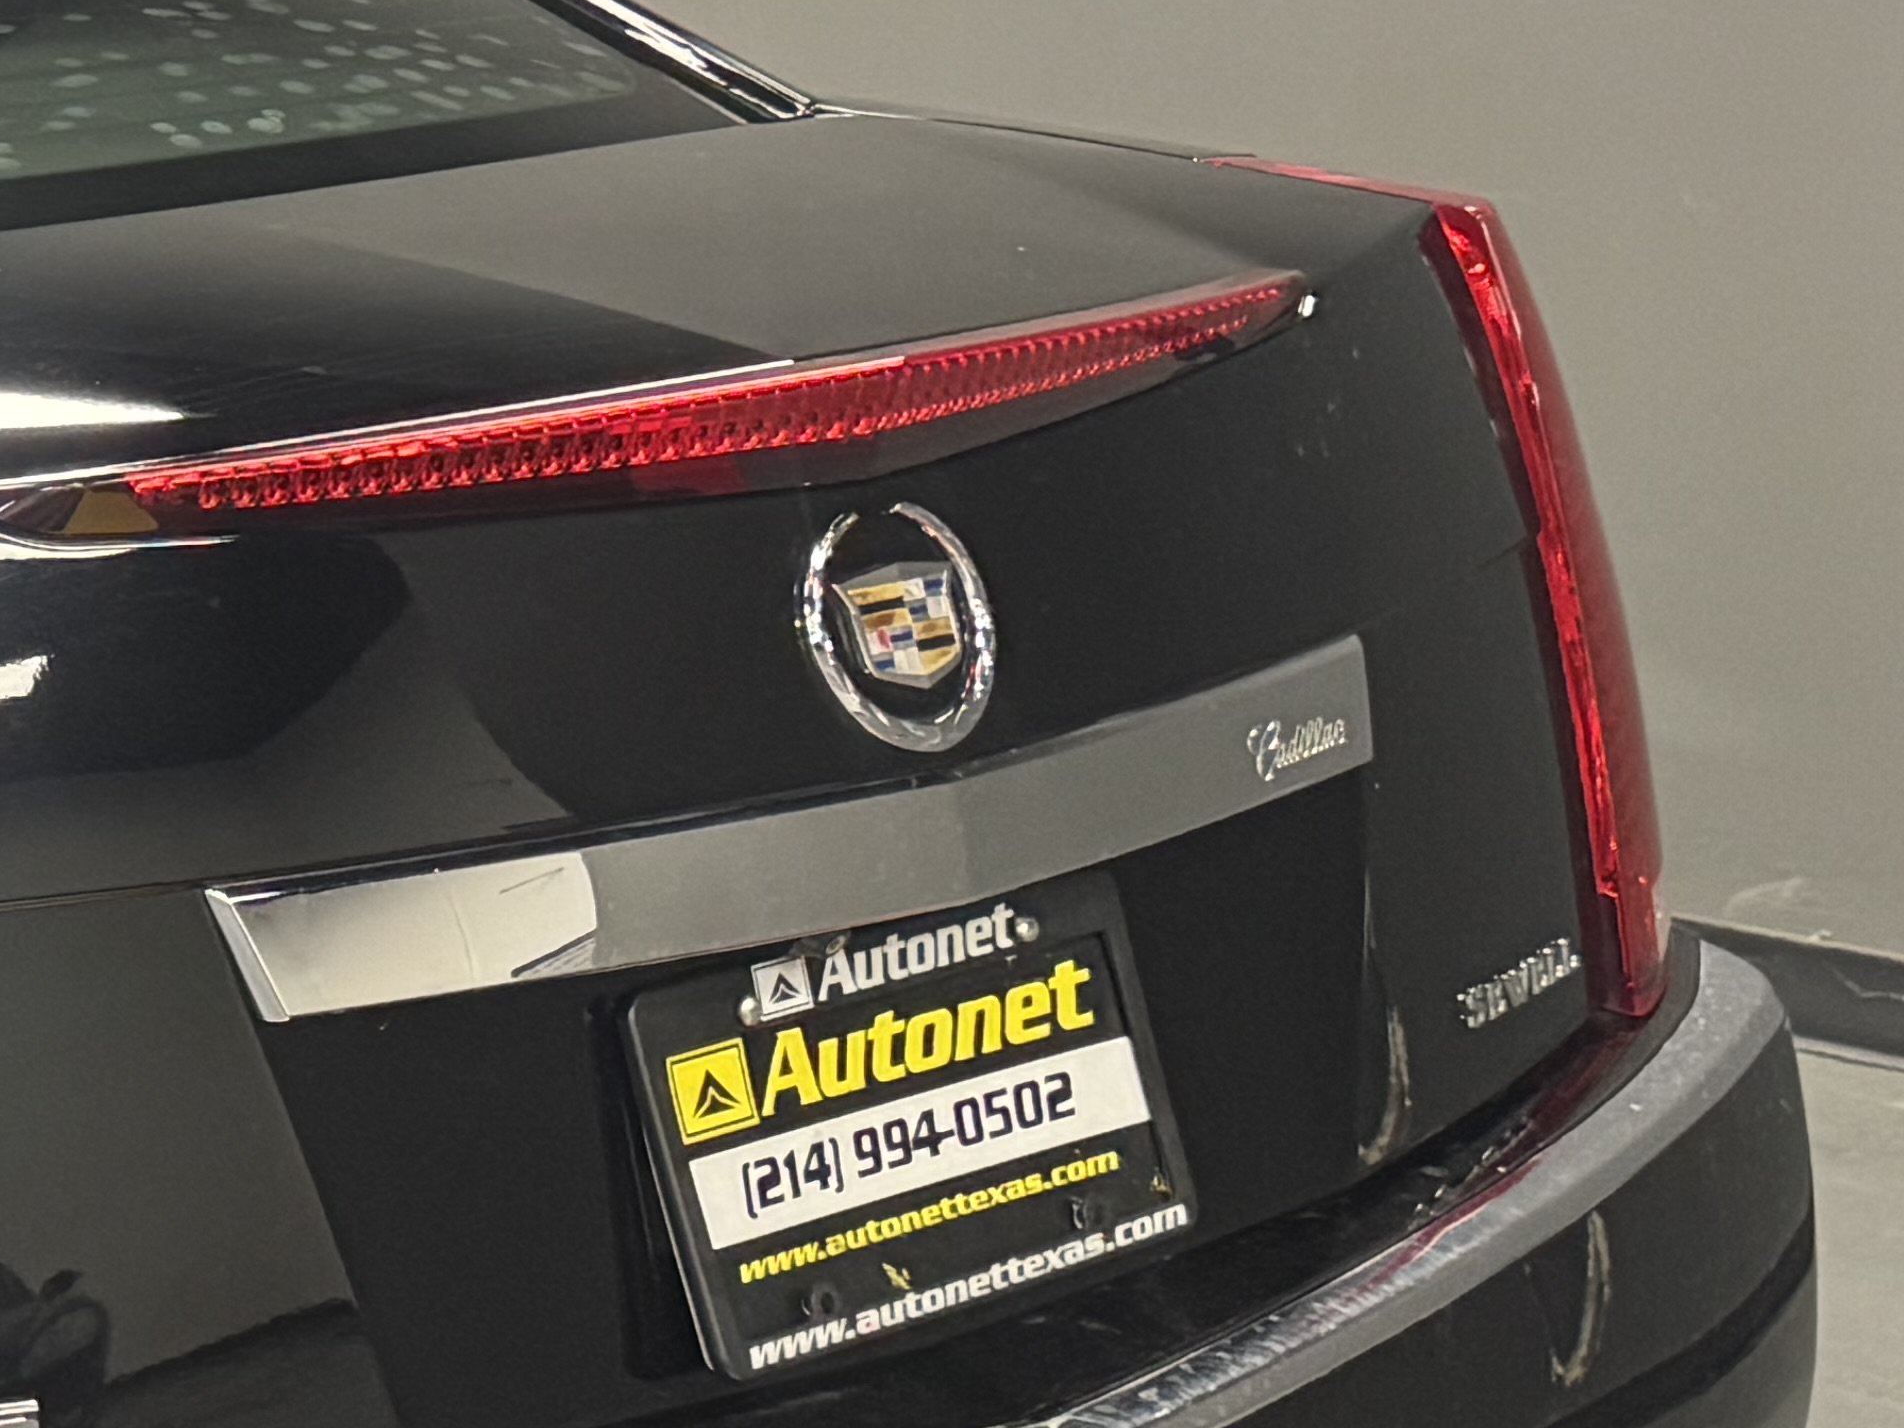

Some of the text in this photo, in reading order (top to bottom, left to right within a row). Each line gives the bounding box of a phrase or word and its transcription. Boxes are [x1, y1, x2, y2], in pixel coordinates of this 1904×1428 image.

[1246, 715, 1348, 782] Cadillac
[817, 901, 1015, 1002] Autonet
[761, 959, 1096, 1117] Autonet
[741, 1071, 1077, 1220] (214) 994-0502
[738, 1149, 1120, 1285] www.autonettexas.com
[748, 1202, 1189, 1371] www.autonettexas.com
